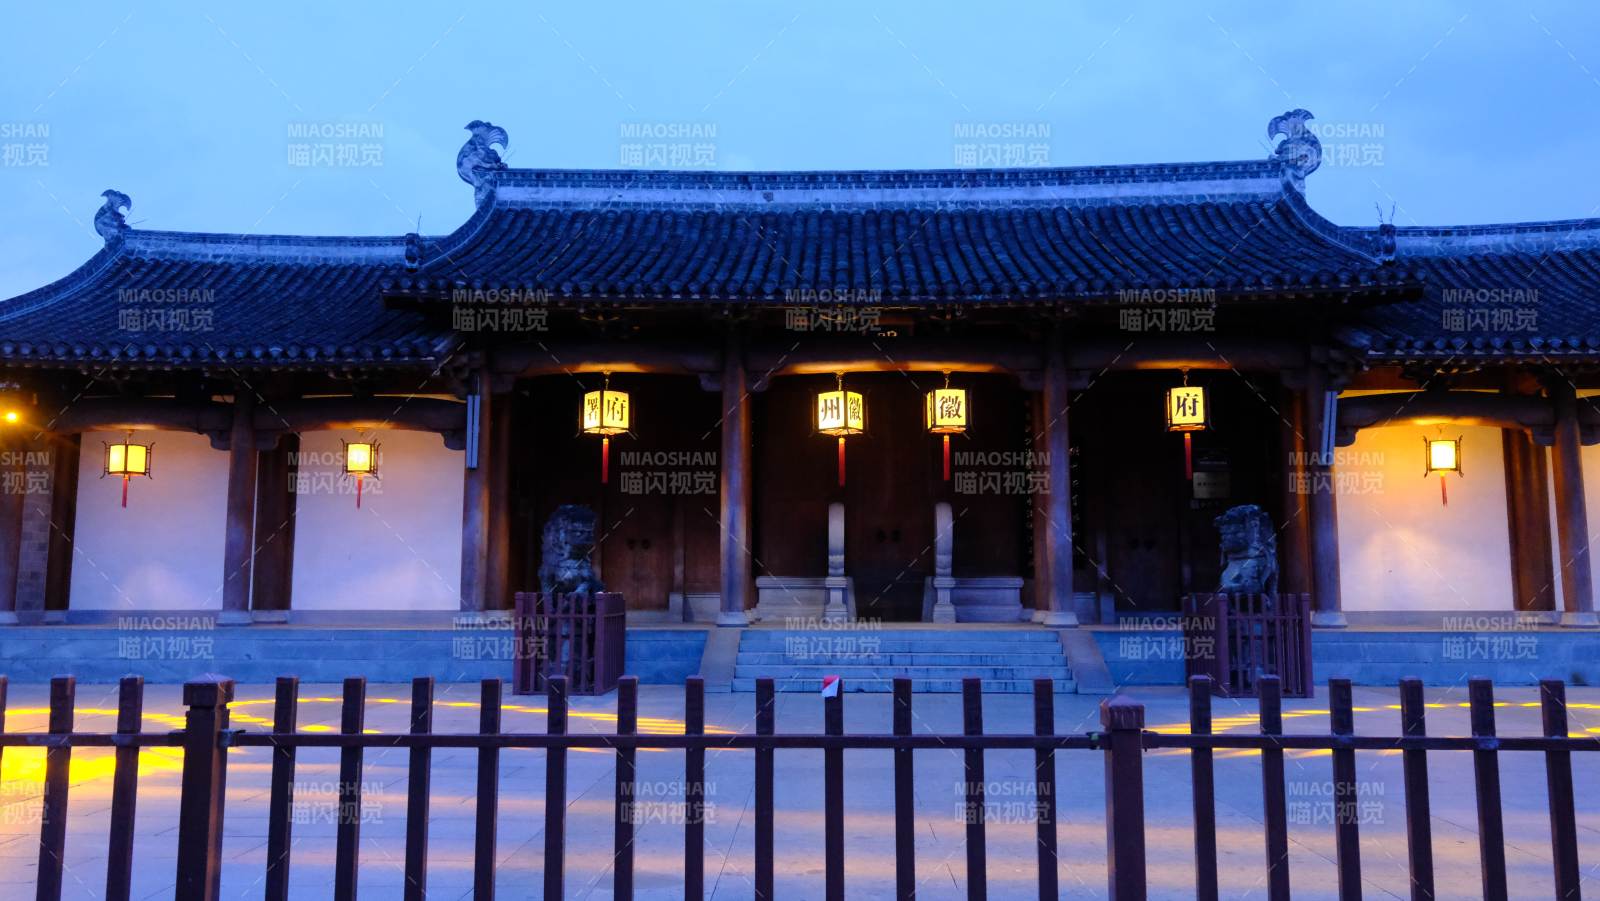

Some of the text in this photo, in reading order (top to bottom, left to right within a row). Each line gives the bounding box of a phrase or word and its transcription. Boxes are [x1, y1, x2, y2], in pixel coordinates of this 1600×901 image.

[606, 396, 626, 421] 府
[821, 396, 841, 421] 州
[848, 396, 862, 421] 徽
[938, 395, 962, 420] 徽
[1175, 392, 1200, 417] 府
